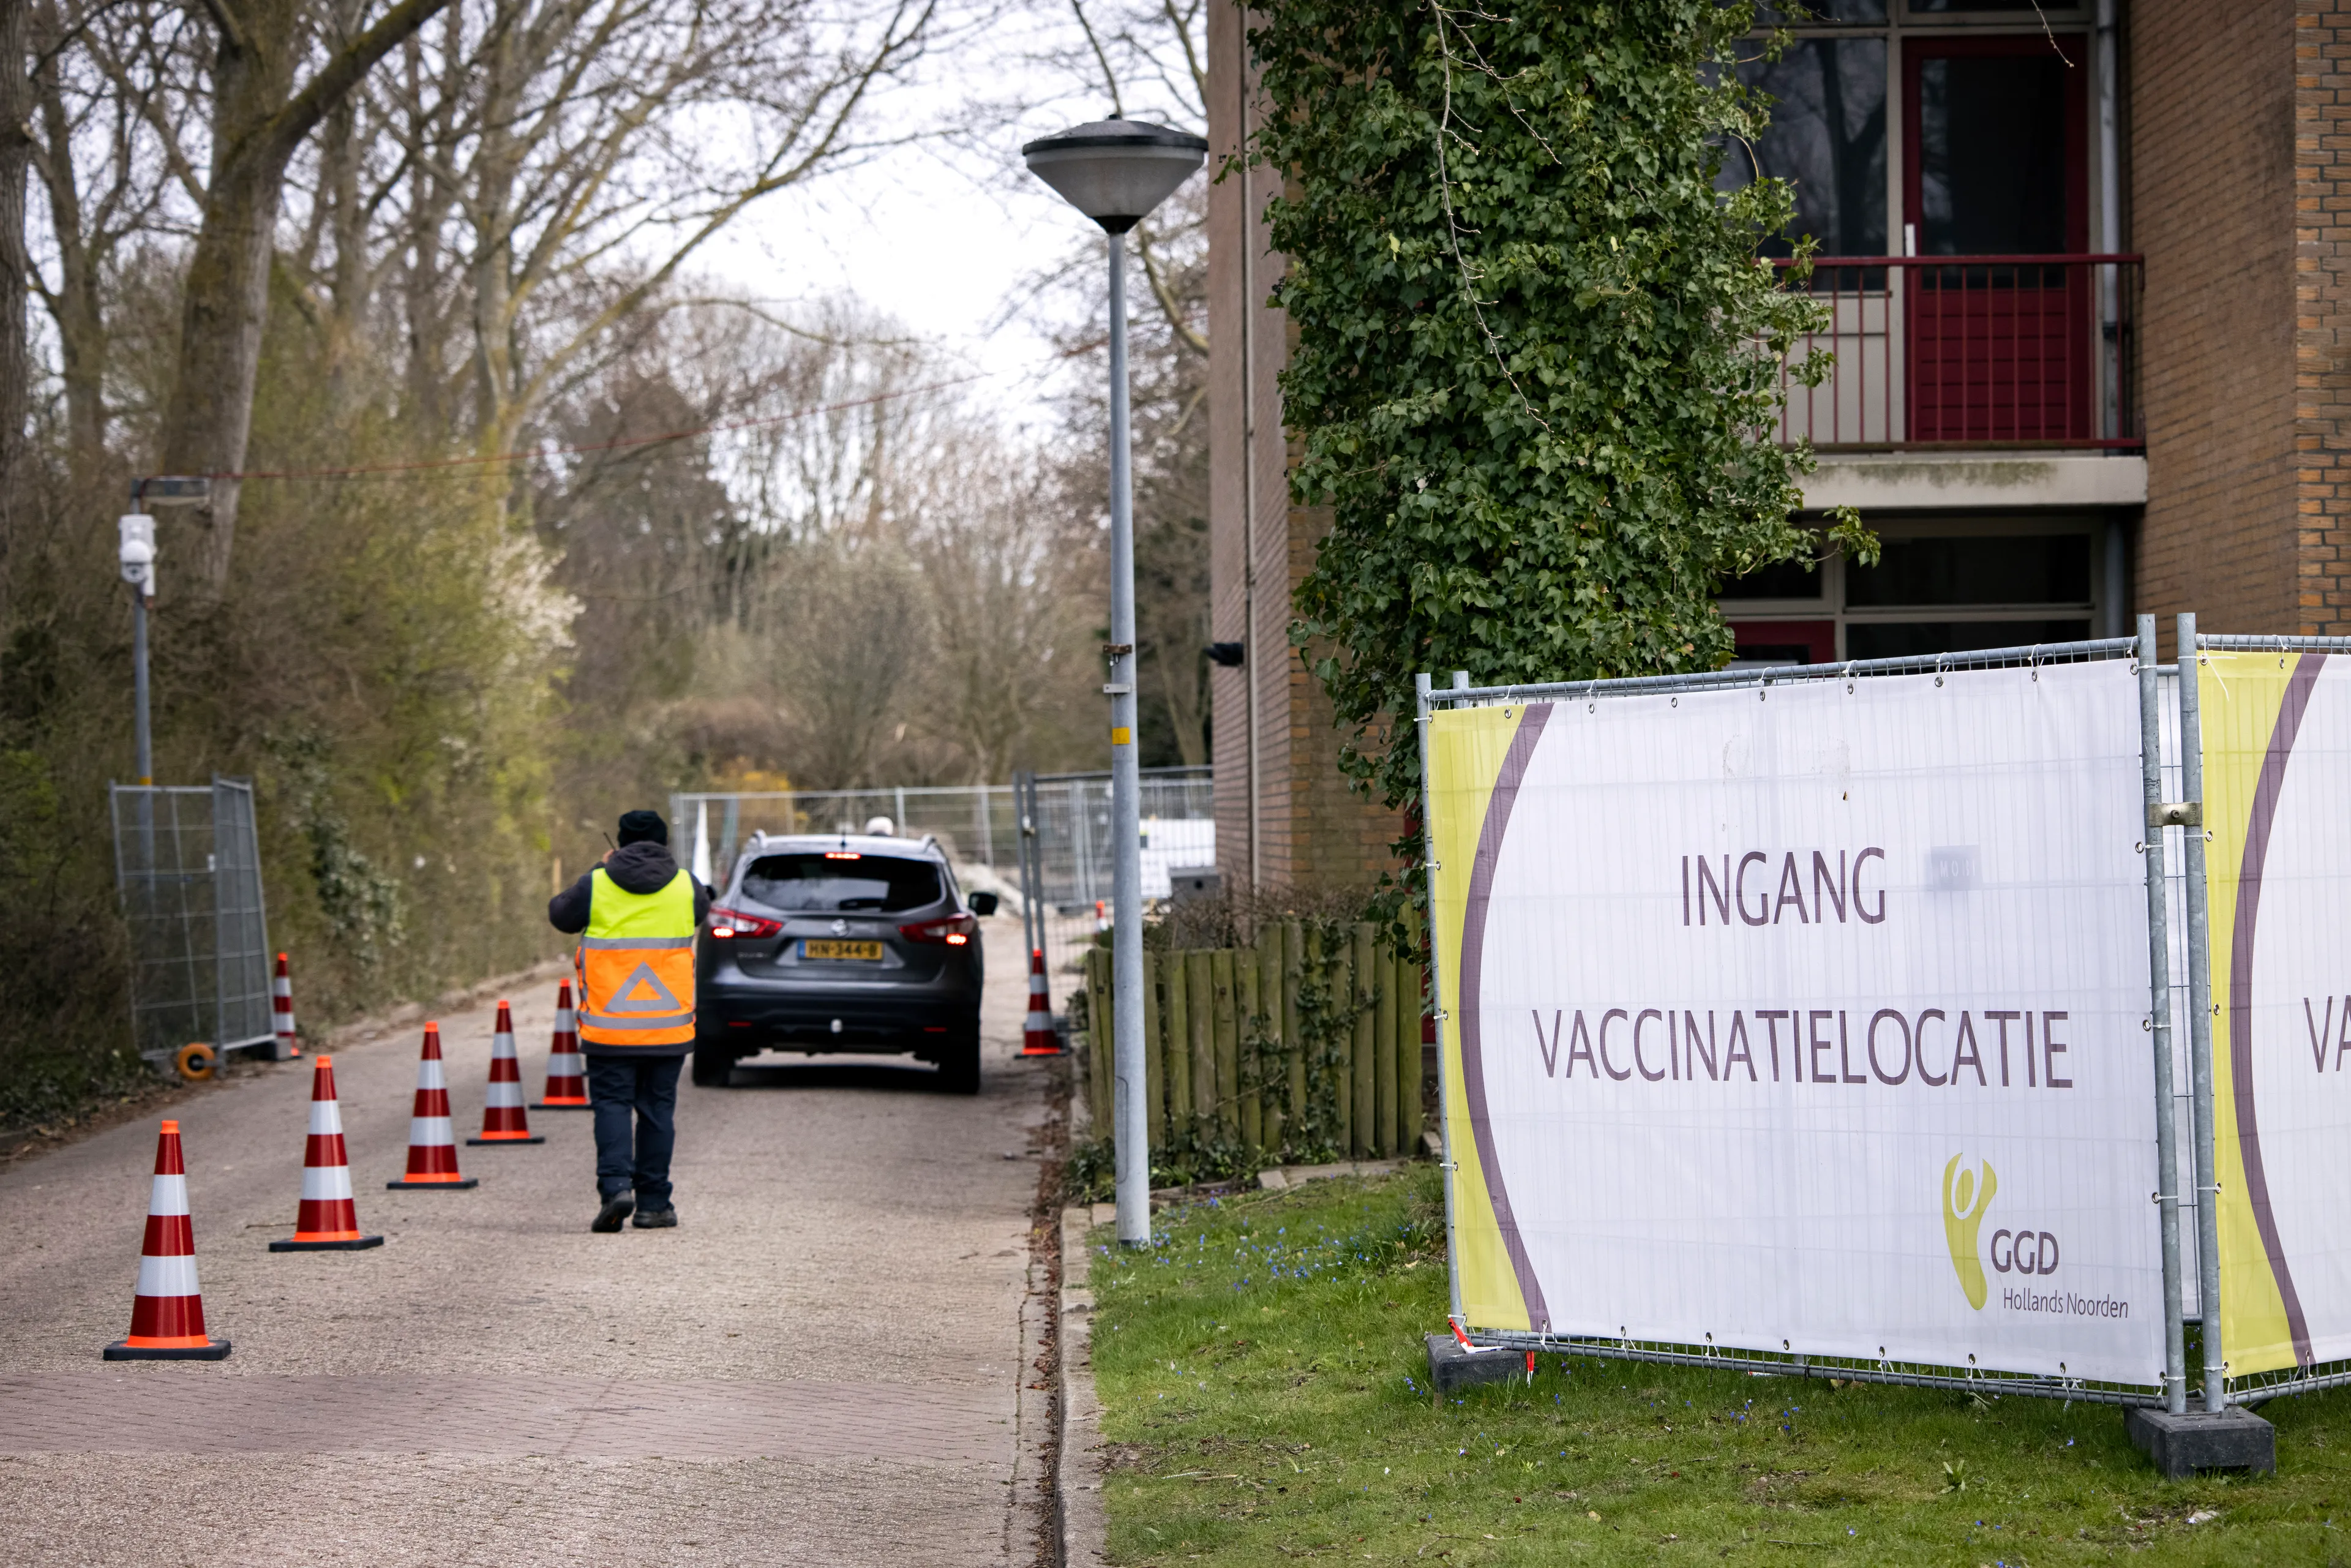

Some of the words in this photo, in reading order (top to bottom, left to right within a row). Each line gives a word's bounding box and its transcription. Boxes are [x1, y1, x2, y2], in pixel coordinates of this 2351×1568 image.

[1682, 847, 1886, 926] INGANG
[1940, 858, 1976, 878] MOBI
[1531, 1008, 2074, 1089] VACCINATIELOCATIE
[1990, 1229, 2060, 1275] GGD
[2003, 1287, 2063, 1313] Hollands
[2066, 1292, 2129, 1318] Noorden
